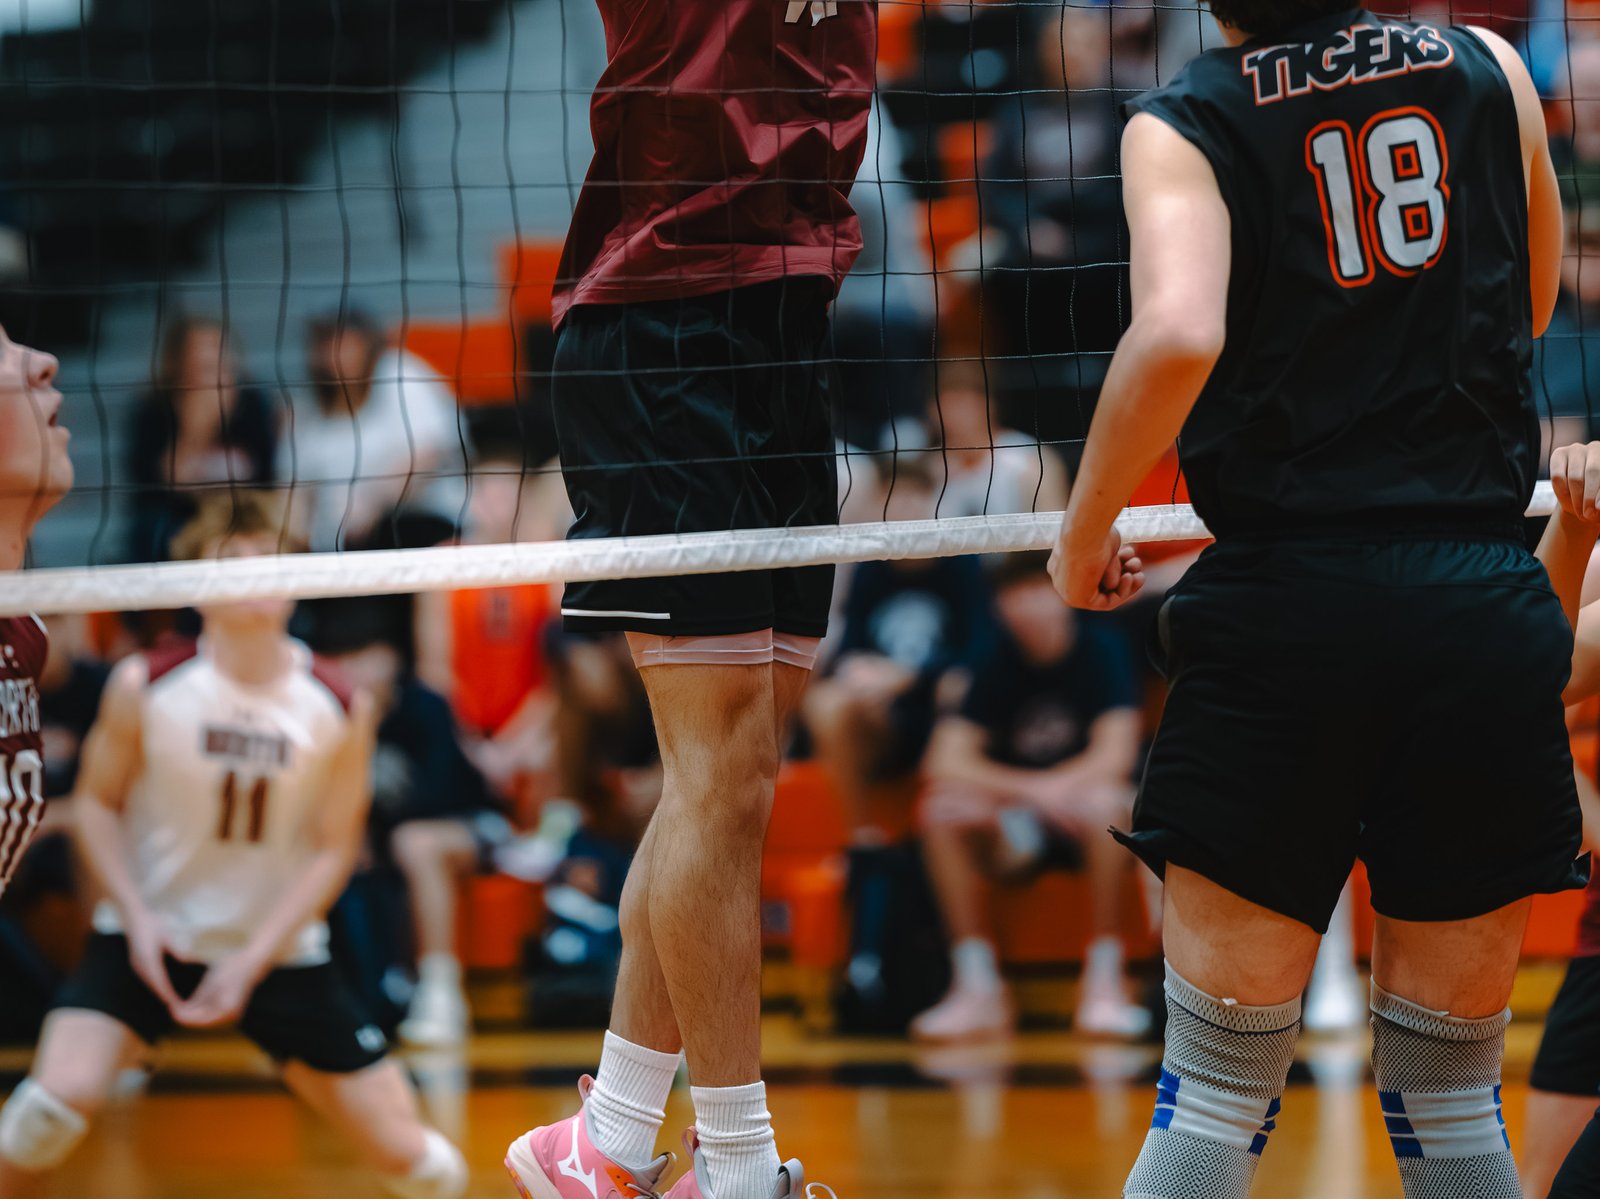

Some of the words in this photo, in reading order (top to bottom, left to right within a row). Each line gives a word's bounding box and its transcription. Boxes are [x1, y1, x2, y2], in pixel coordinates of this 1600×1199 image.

[1241, 23, 1455, 106] TIGERS
[1304, 105, 1451, 289] 18
[216, 768, 270, 843] 11
